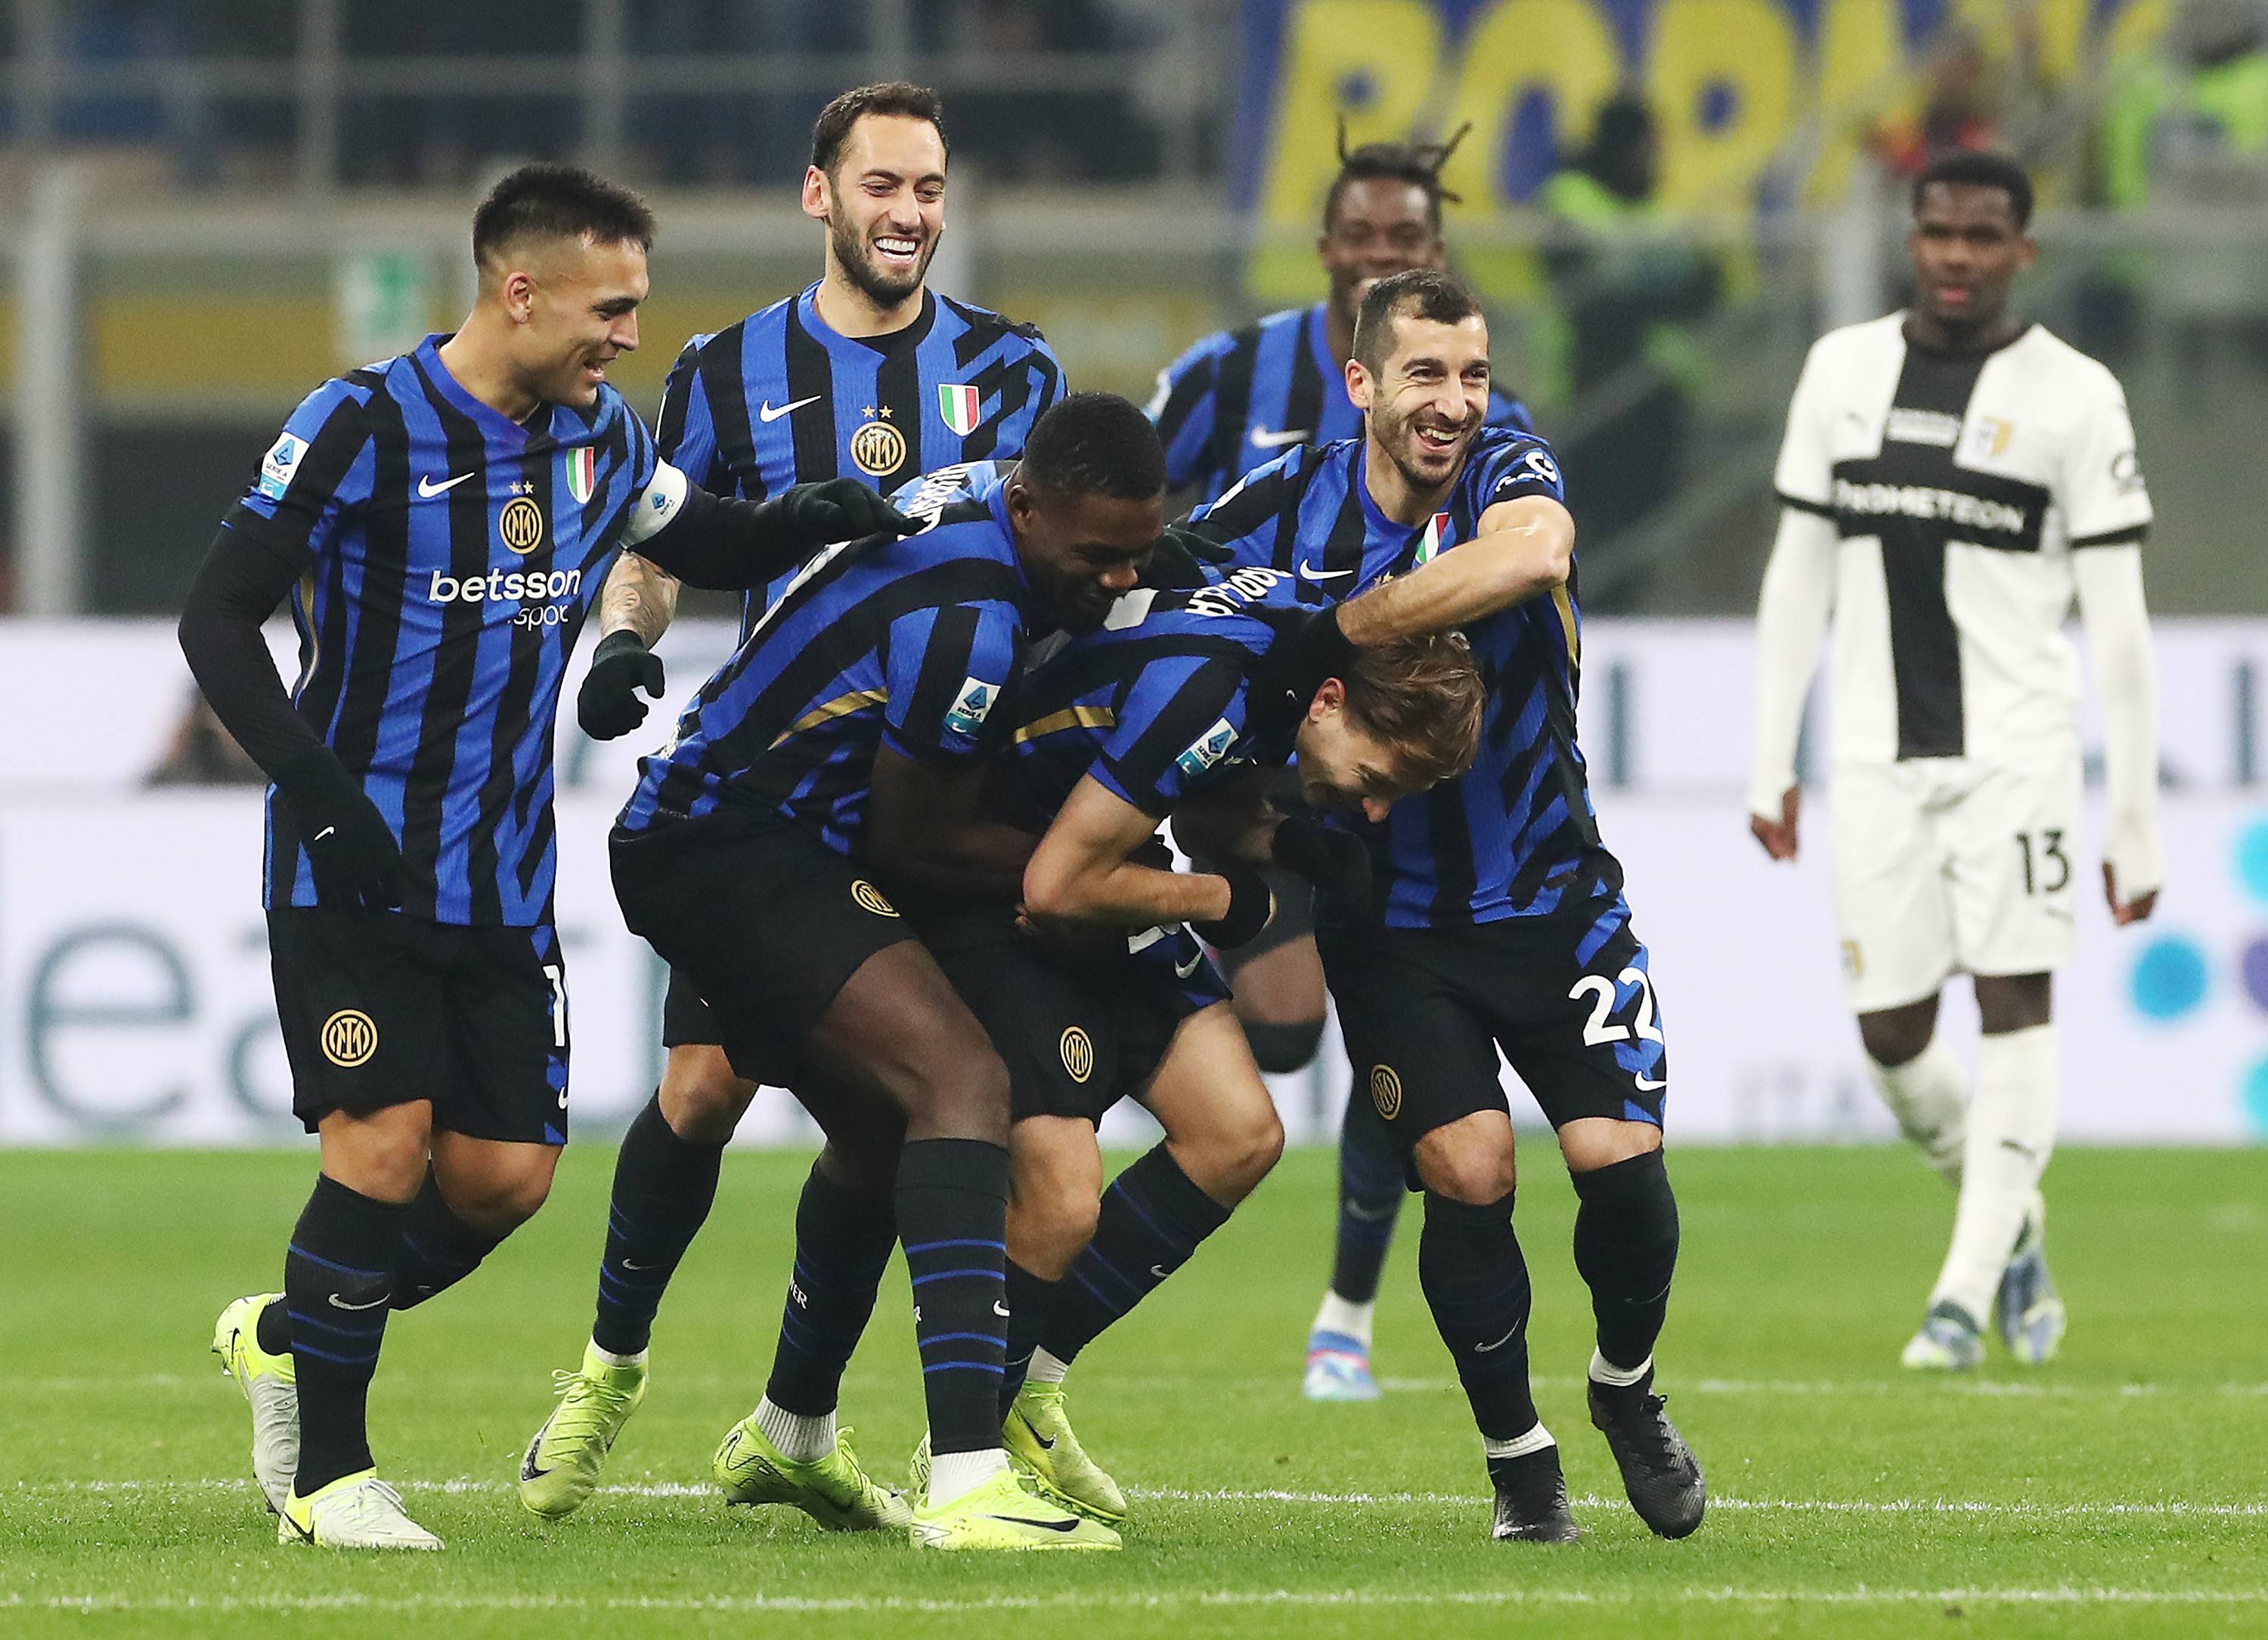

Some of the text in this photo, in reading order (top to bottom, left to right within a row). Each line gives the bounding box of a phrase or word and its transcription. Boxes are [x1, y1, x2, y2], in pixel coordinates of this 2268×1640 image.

[429, 568, 581, 603] betsson
[2015, 829, 2069, 895] 13
[1568, 967, 1664, 1046] 22
